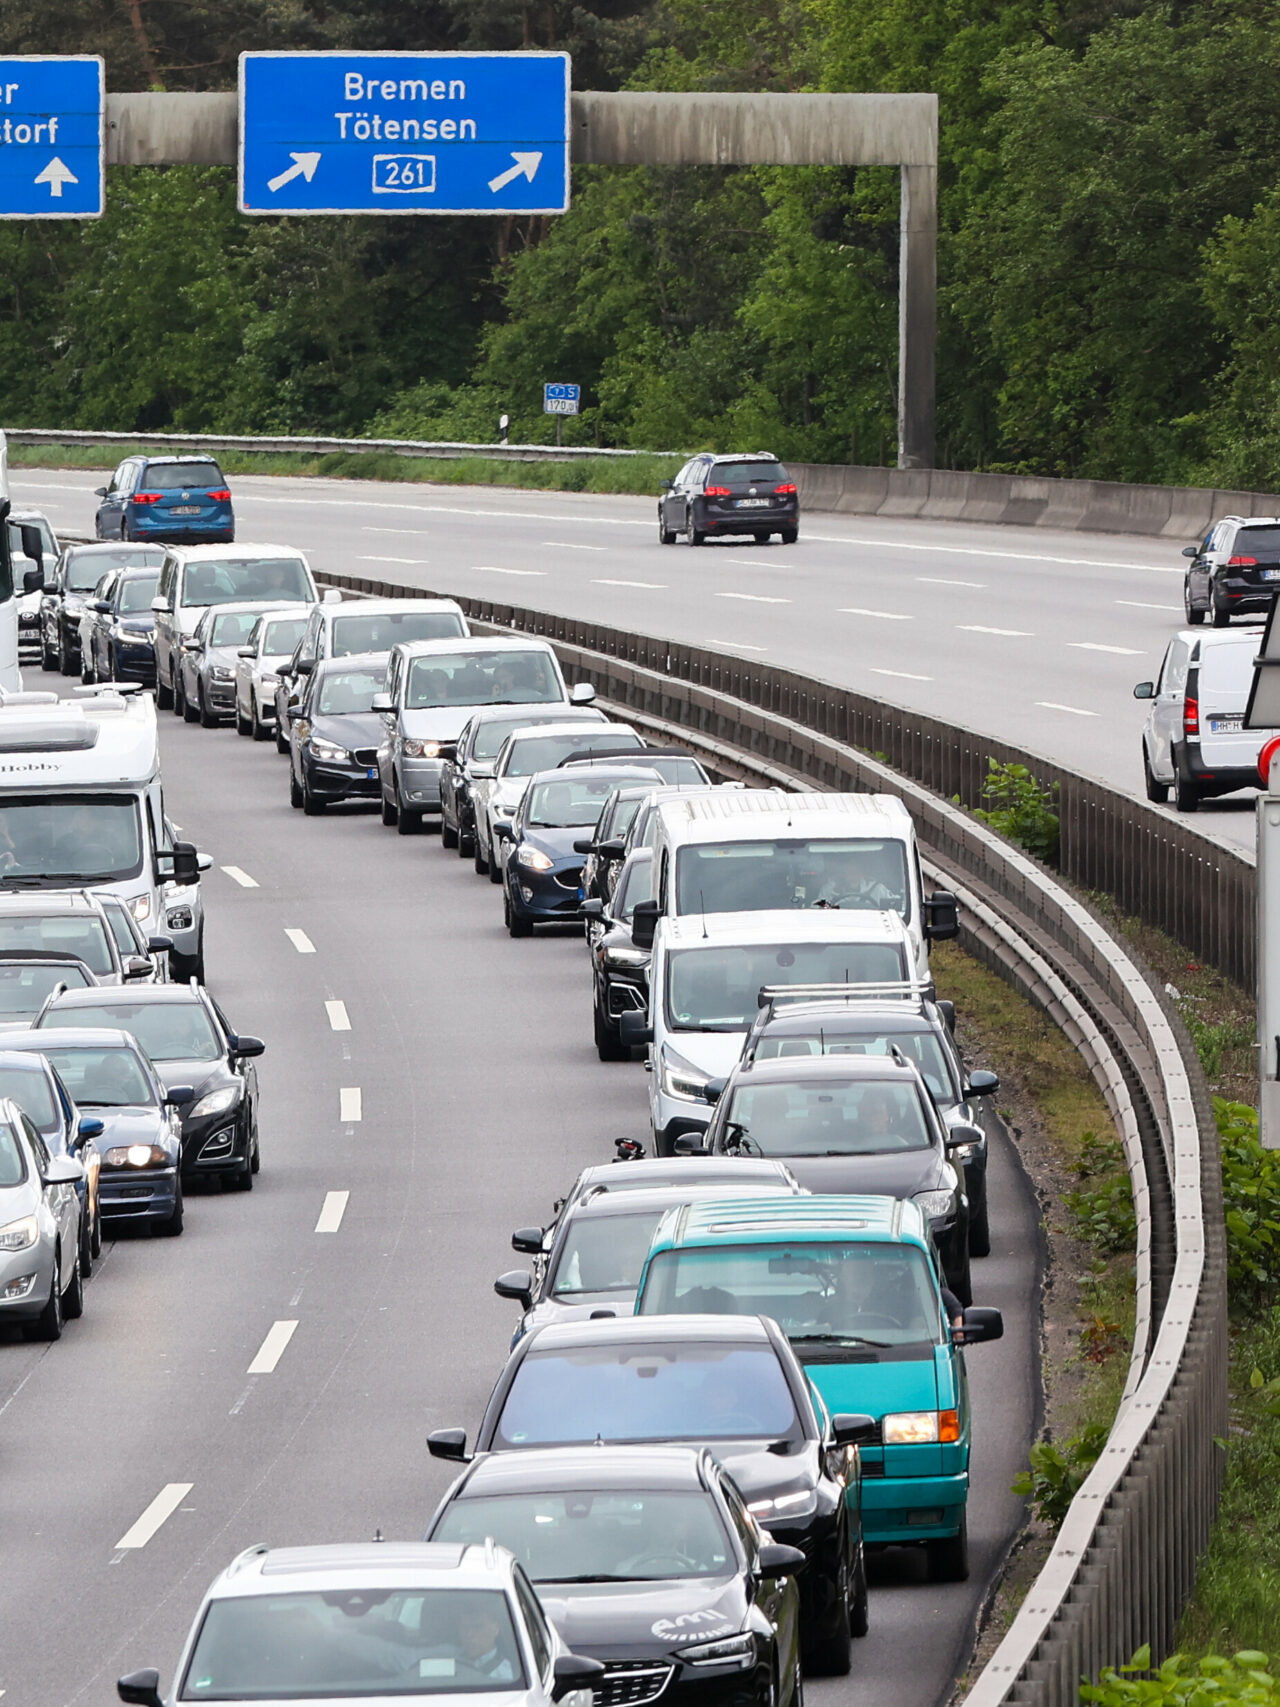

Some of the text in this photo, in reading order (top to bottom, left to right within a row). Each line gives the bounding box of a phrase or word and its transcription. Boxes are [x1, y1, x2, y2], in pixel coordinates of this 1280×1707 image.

[344, 72, 466, 101] Bremen
[334, 112, 477, 140] Tötensen
[385, 162, 424, 185] 261
[567, 387, 575, 398] S
[1, 763, 62, 773] Hobby
